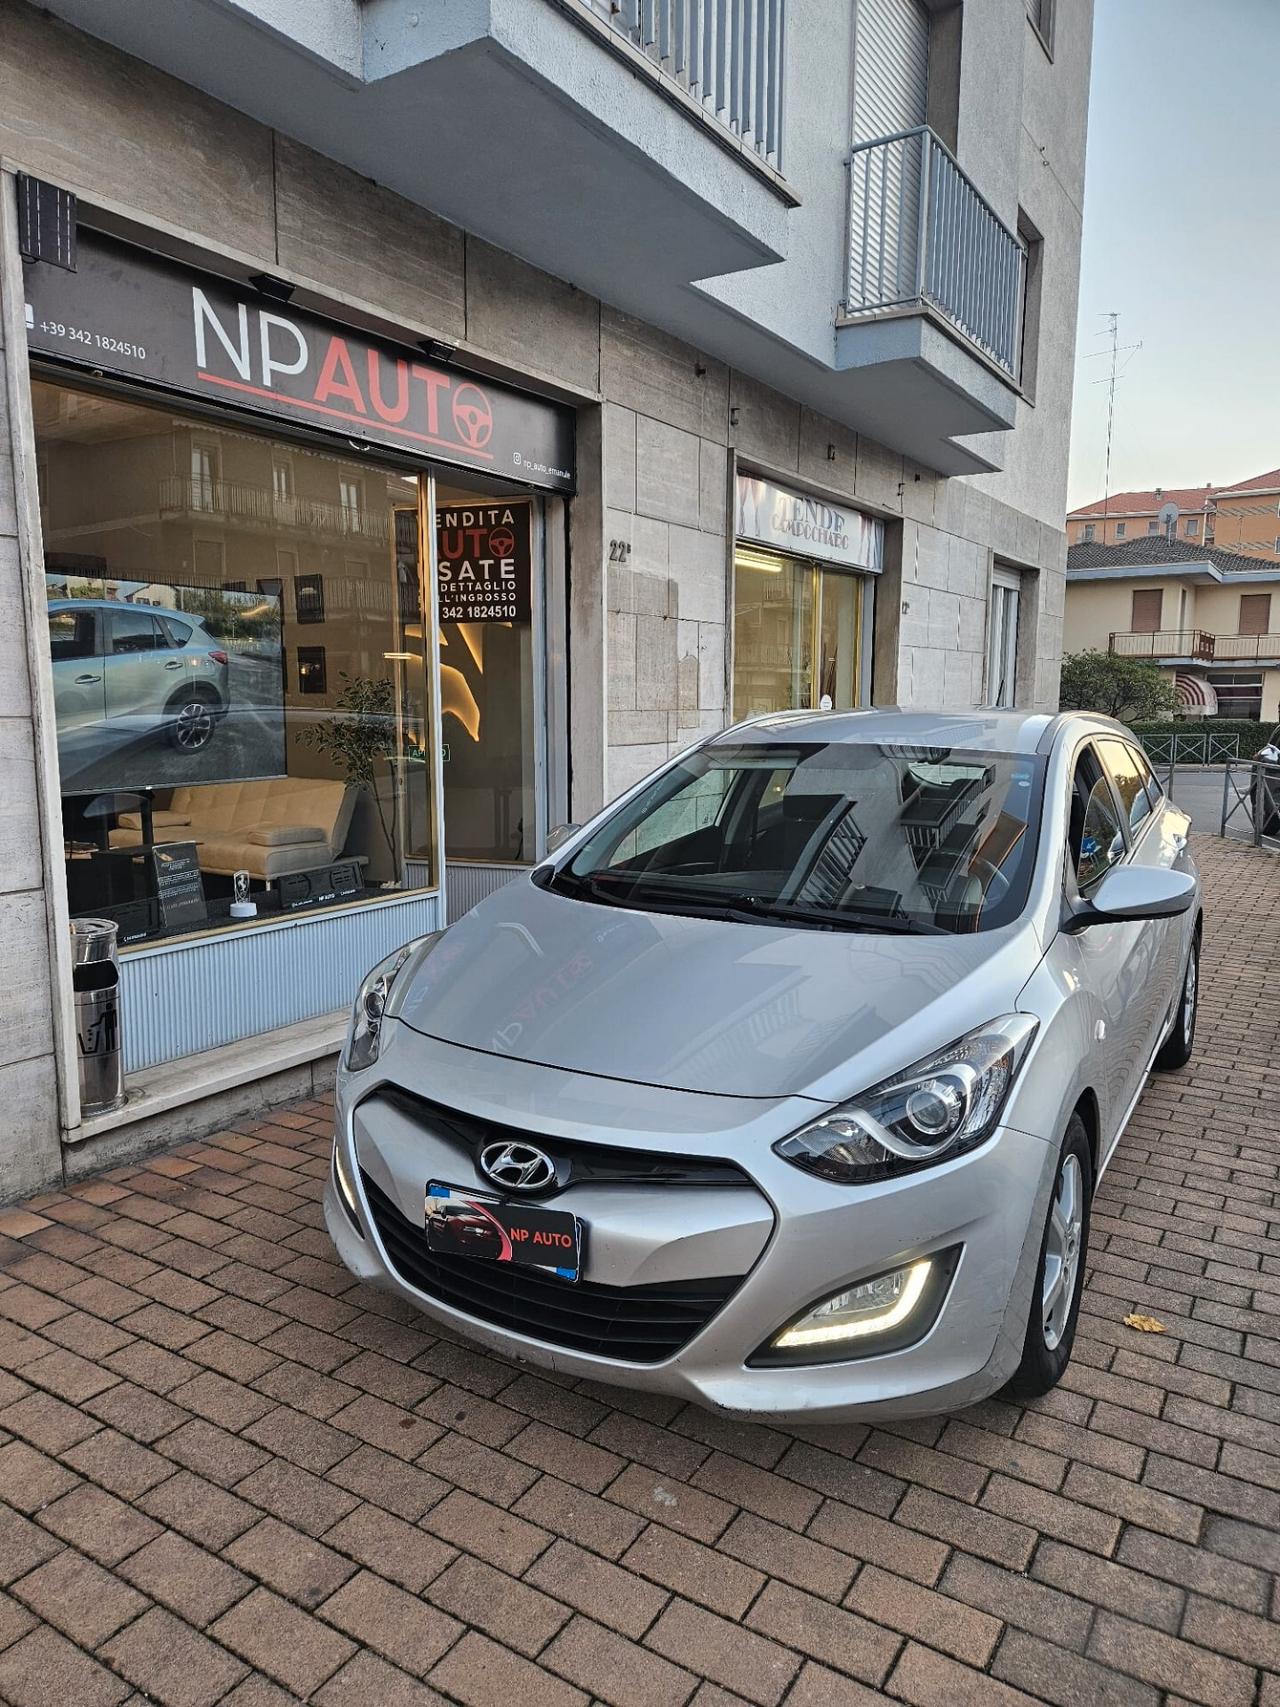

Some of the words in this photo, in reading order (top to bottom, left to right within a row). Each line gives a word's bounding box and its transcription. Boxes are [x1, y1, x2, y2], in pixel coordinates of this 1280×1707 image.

[40, 321, 66, 337] +39
[68, 327, 92, 345] 342
[95, 335, 146, 359] 1824510
[435, 509, 515, 528] ENDITA
[437, 527, 515, 560] UTO
[438, 559, 516, 581] SATE
[440, 580, 517, 593] DETTAGLIO
[442, 606, 464, 619] 342
[467, 605, 517, 618] 1824510
[510, 1227, 529, 1241] NP
[532, 1231, 572, 1248] AUTO
